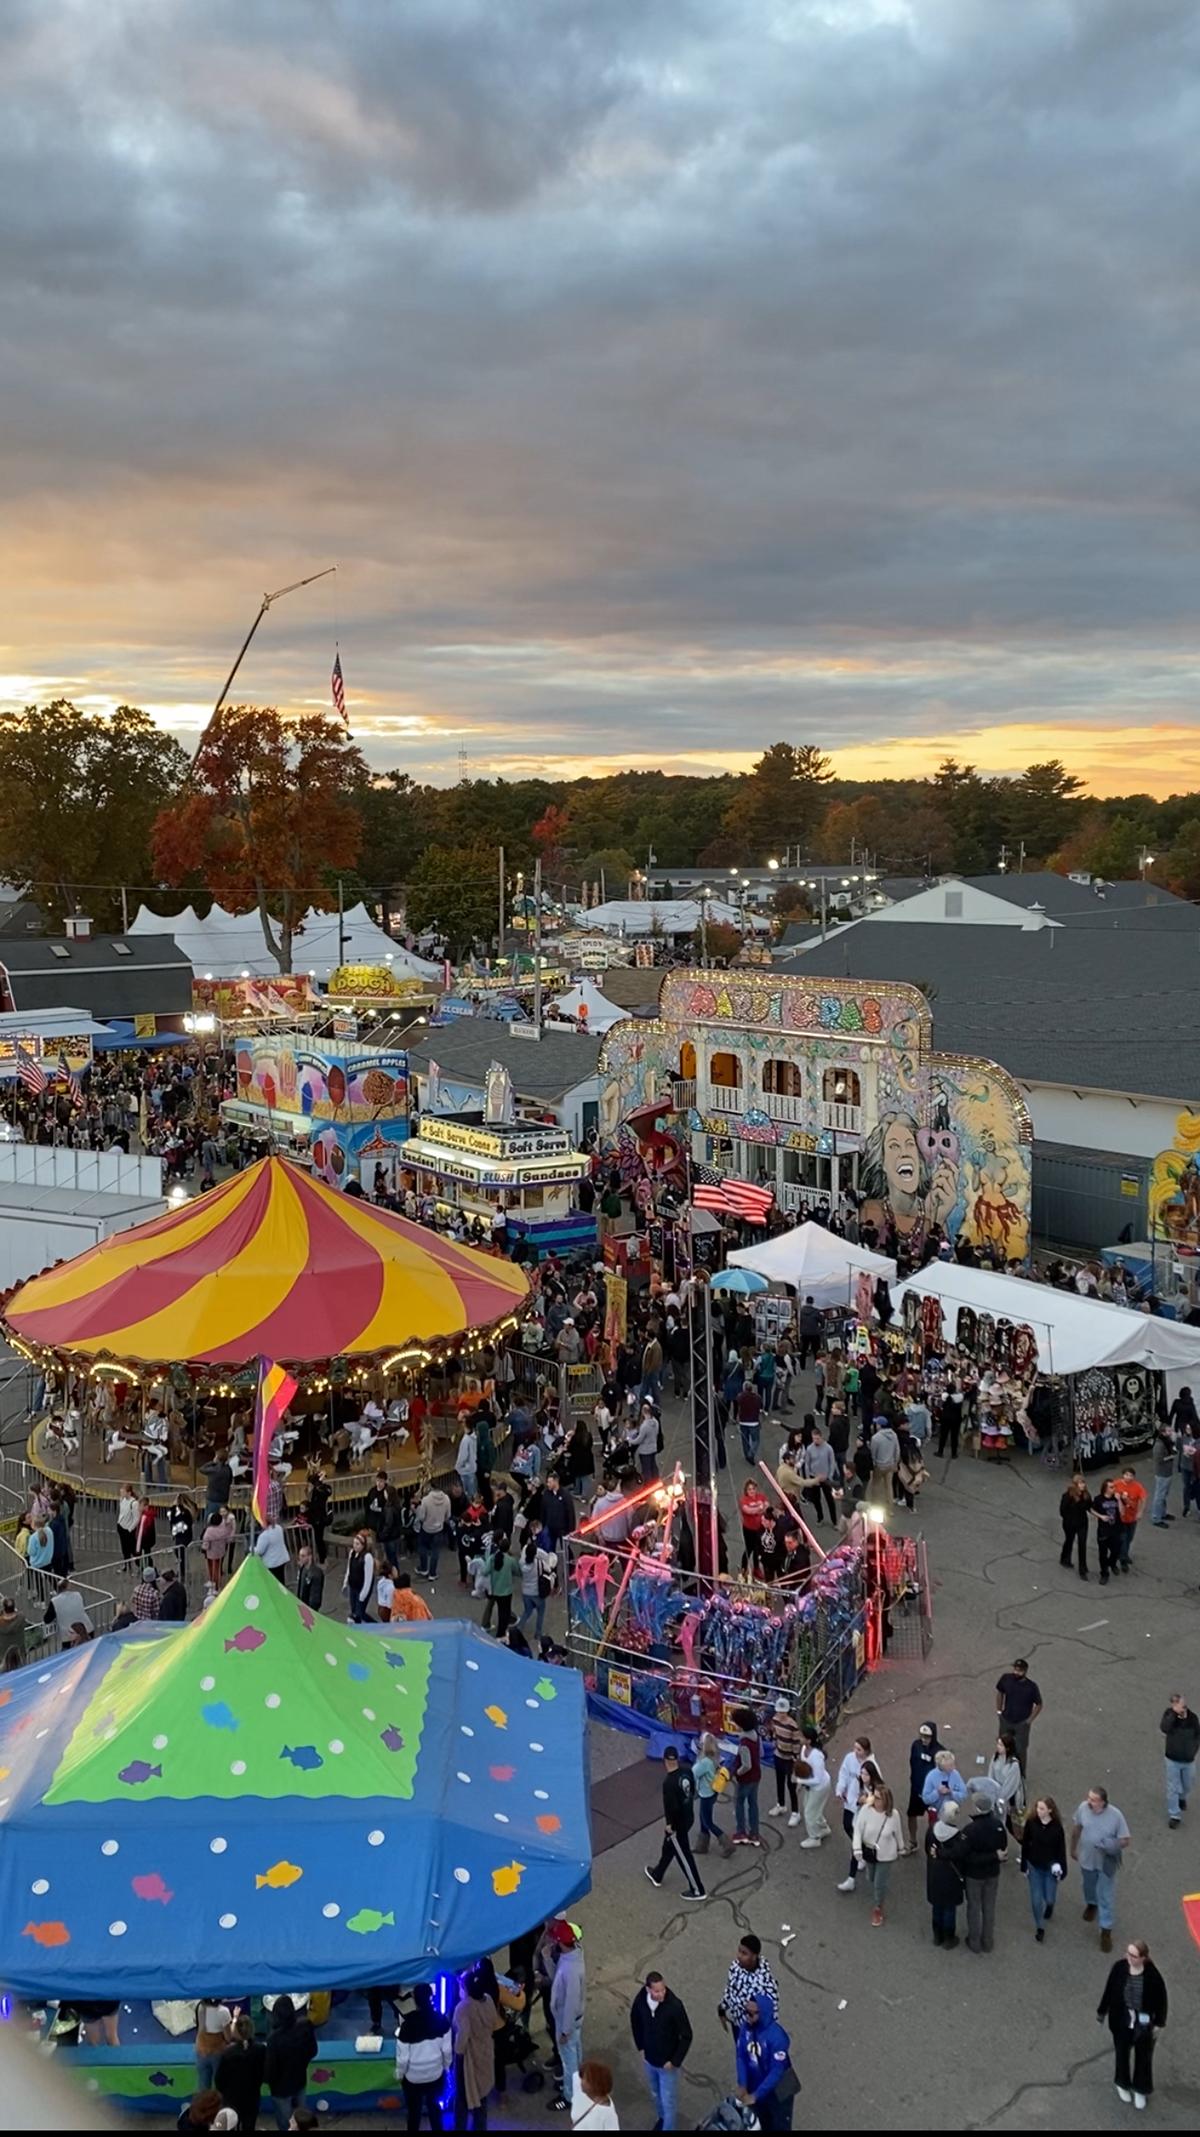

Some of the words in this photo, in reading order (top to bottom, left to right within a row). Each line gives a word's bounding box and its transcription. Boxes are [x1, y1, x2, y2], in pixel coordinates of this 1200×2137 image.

[342, 965, 387, 977] FRIED
[338, 977, 390, 990] DOUGH
[453, 1006, 473, 1016] CREAM
[690, 985, 784, 1026] MARDI
[791, 993, 883, 1033] GRAS
[348, 1059, 380, 1072] CARAMEL
[382, 1058, 406, 1068] APPLES
[429, 1125, 444, 1139] Soft
[447, 1129, 466, 1145] Serve
[469, 1135, 491, 1151] Cones
[508, 1141, 532, 1153] Soft
[536, 1139, 566, 1151] Serve
[444, 1163, 474, 1179] Floats
[482, 1171, 515, 1183] SLUSH
[522, 1169, 579, 1182] Sundaes
